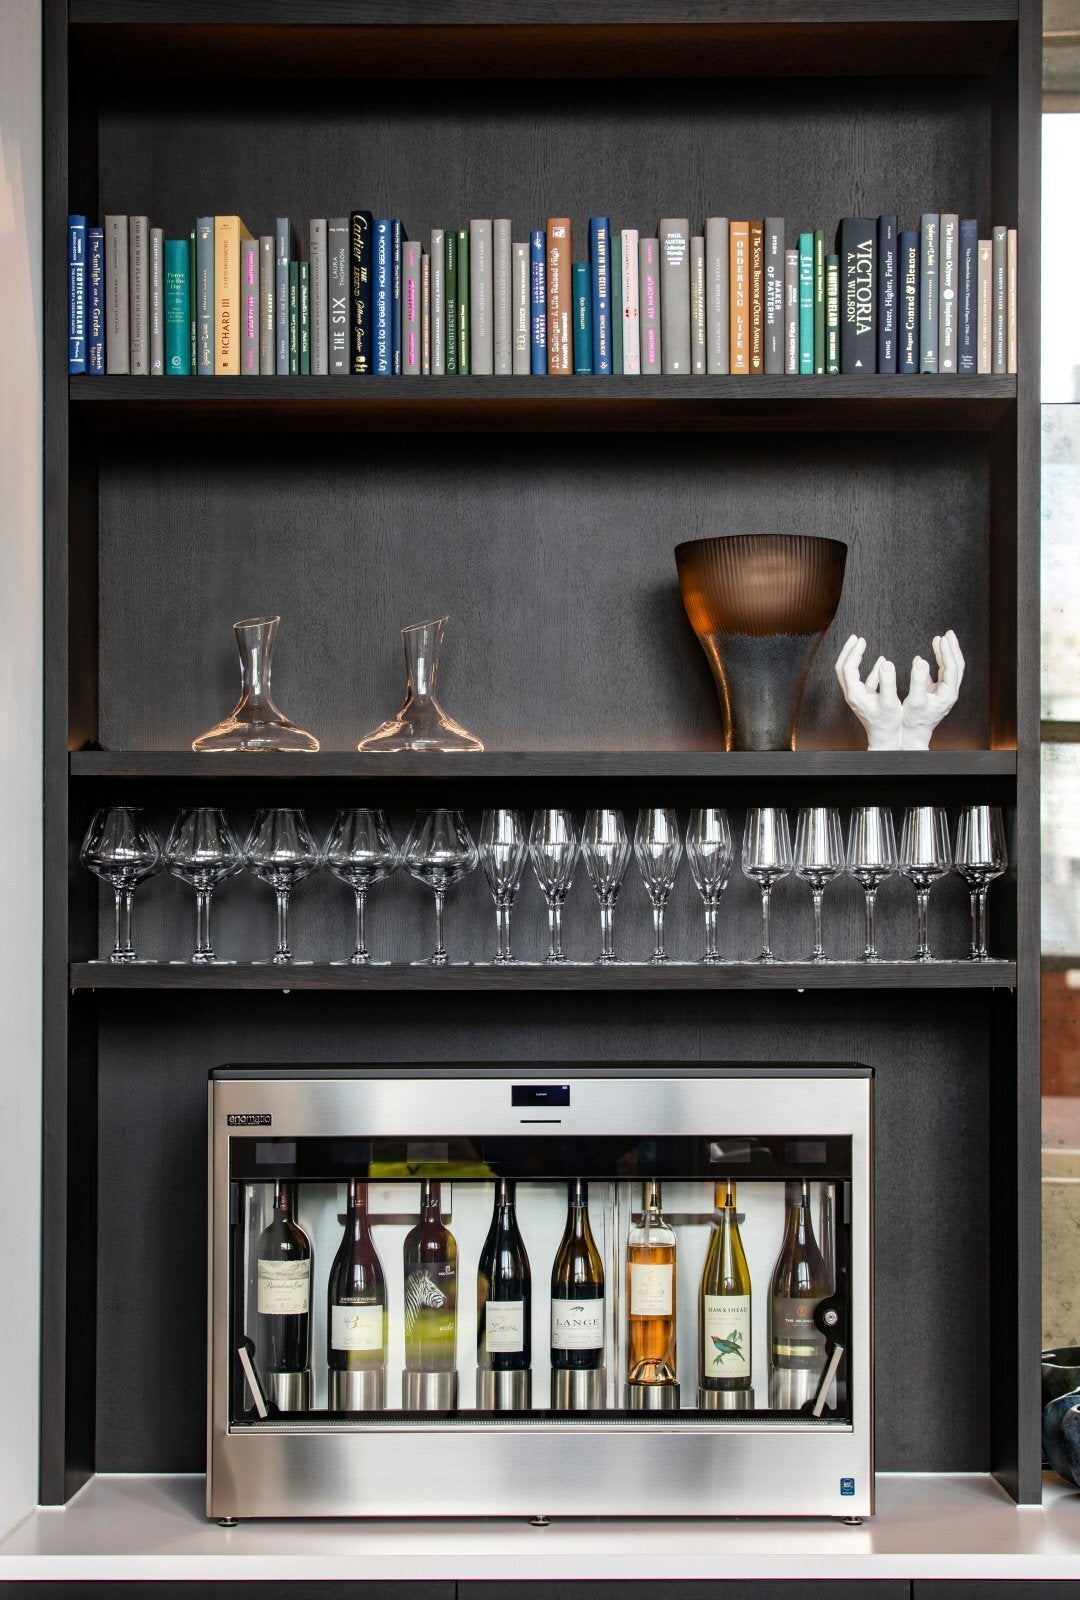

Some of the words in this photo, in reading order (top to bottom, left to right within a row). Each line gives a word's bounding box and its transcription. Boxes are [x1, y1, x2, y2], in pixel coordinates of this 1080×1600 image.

[353, 214, 368, 262] Cartier
[597, 229, 605, 240] THE
[946, 222, 954, 236] The
[550, 248, 559, 266] High
[597, 241, 605, 256] LADY
[847, 252, 856, 262] A.
[946, 236, 954, 260] Human
[92, 254, 101, 286] Sunlight
[598, 265, 606, 276] THE
[767, 266, 775, 278] OF
[847, 265, 856, 277] N.
[885, 251, 893, 277] Farther
[906, 248, 916, 285] Eleanor
[943, 260, 953, 286] Odyssey
[551, 268, 559, 294] Raised
[598, 276, 606, 298] CELLAR
[828, 271, 838, 297] UNITED
[856, 239, 872, 336] VICTORIA
[885, 279, 894, 307] Higher,
[906, 285, 916, 295] &
[221, 298, 230, 308] III
[333, 297, 345, 323] SIX
[354, 299, 365, 325] Gilberte
[377, 291, 386, 328] breathe
[828, 297, 838, 326] IRELAND
[847, 280, 856, 323] WILSON
[906, 296, 915, 330] Conrad
[944, 301, 953, 326] Stephen
[93, 308, 101, 337] Garden
[517, 307, 526, 332] James
[885, 308, 893, 332] Faster,
[221, 311, 230, 355] RICHARD
[334, 332, 345, 351] THE
[378, 329, 385, 339] to
[551, 318, 560, 353] Salinger:
[944, 326, 952, 346] Green
[377, 341, 385, 357] not
[378, 359, 388, 371] try
[228, 1115, 271, 1123] enomatic
